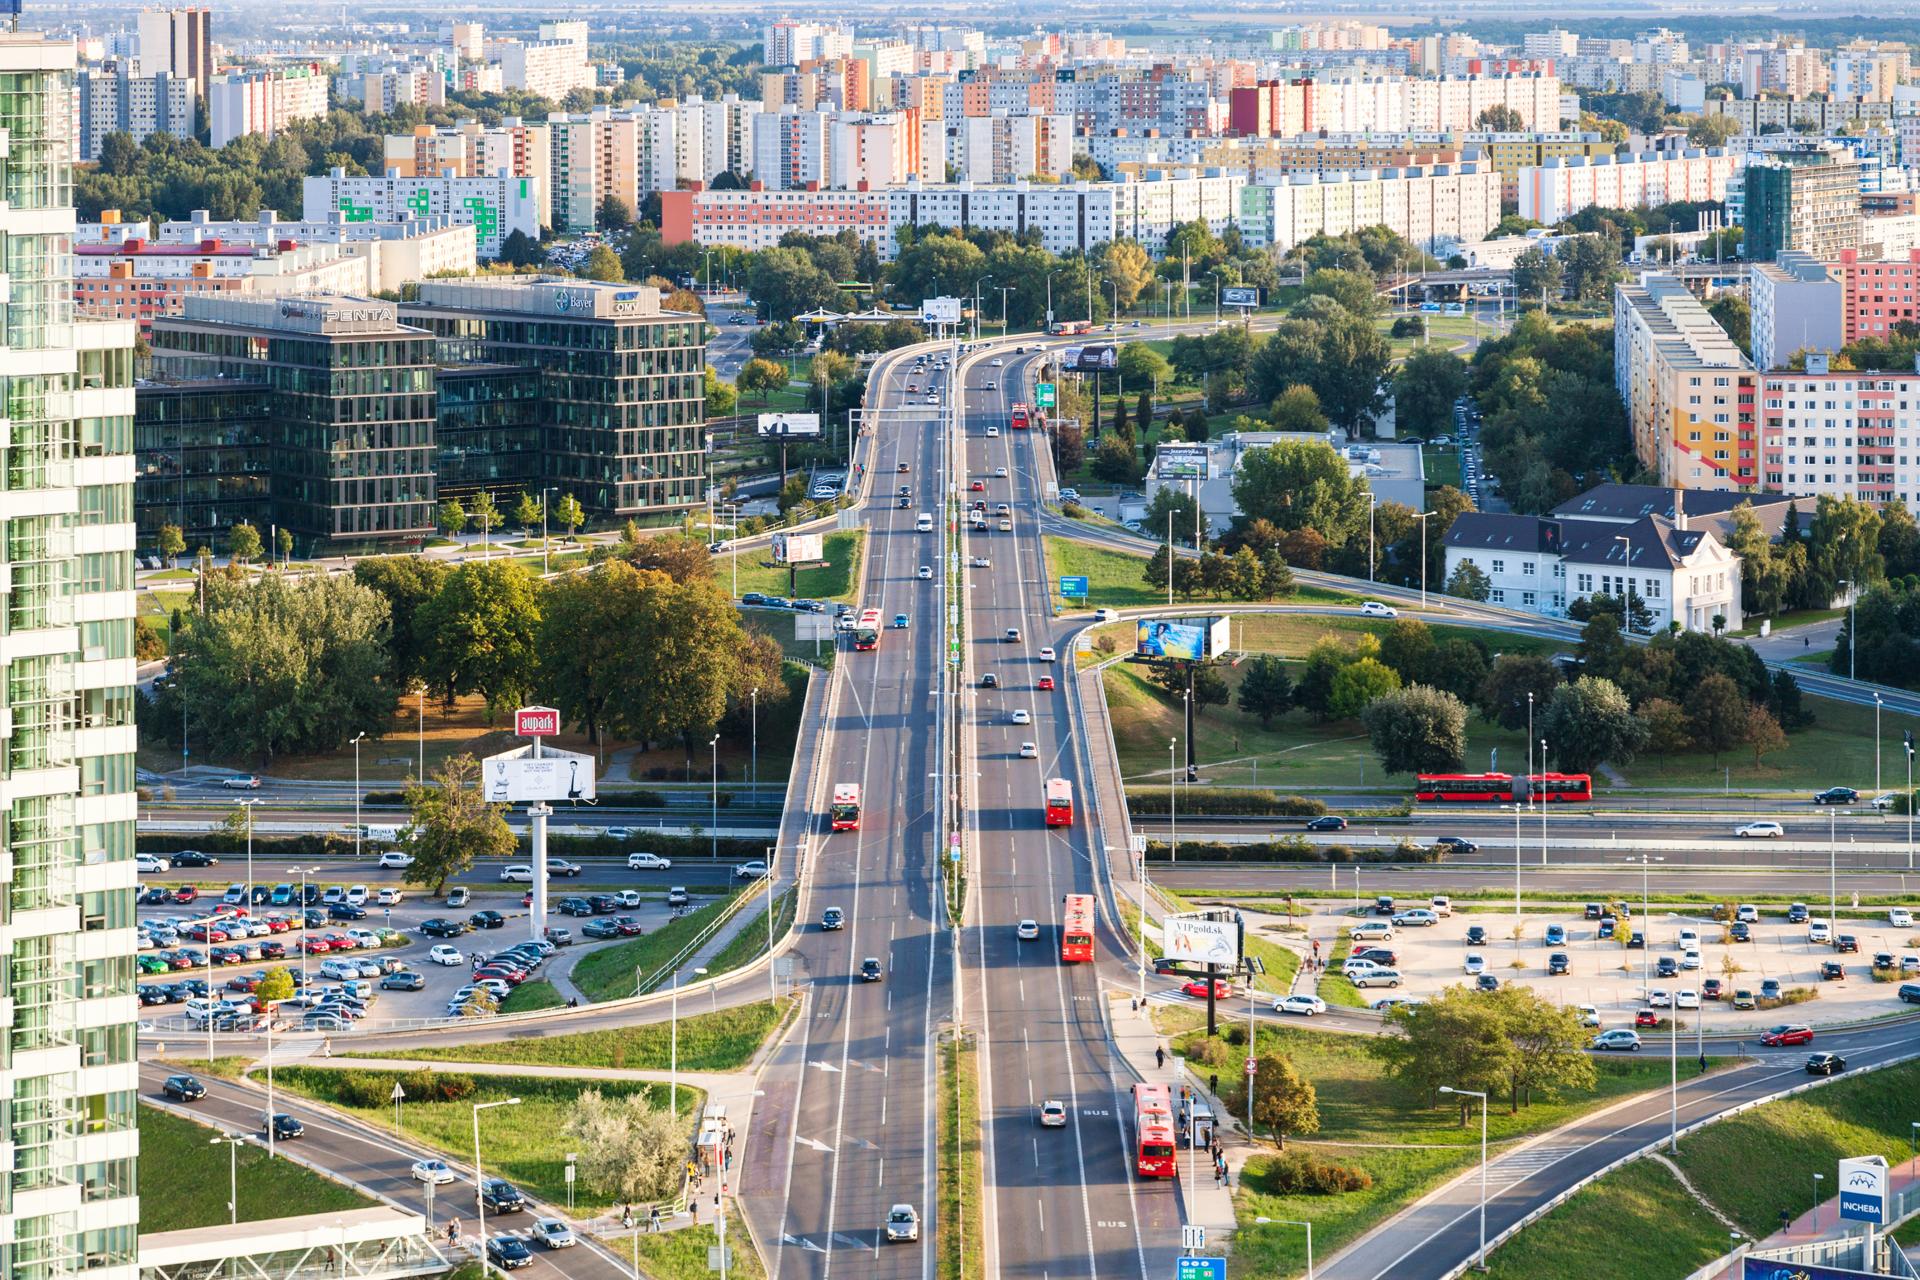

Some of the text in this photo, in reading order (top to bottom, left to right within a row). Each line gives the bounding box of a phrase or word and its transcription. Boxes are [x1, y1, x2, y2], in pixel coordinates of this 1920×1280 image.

[570, 296, 593, 311] Bayer
[616, 303, 639, 312] OMV
[326, 308, 393, 322] PENTA
[521, 714, 554, 731] aupark
[1177, 922, 1223, 935] VIPgold.sk
[1843, 1201, 1881, 1215] INCHEBA
